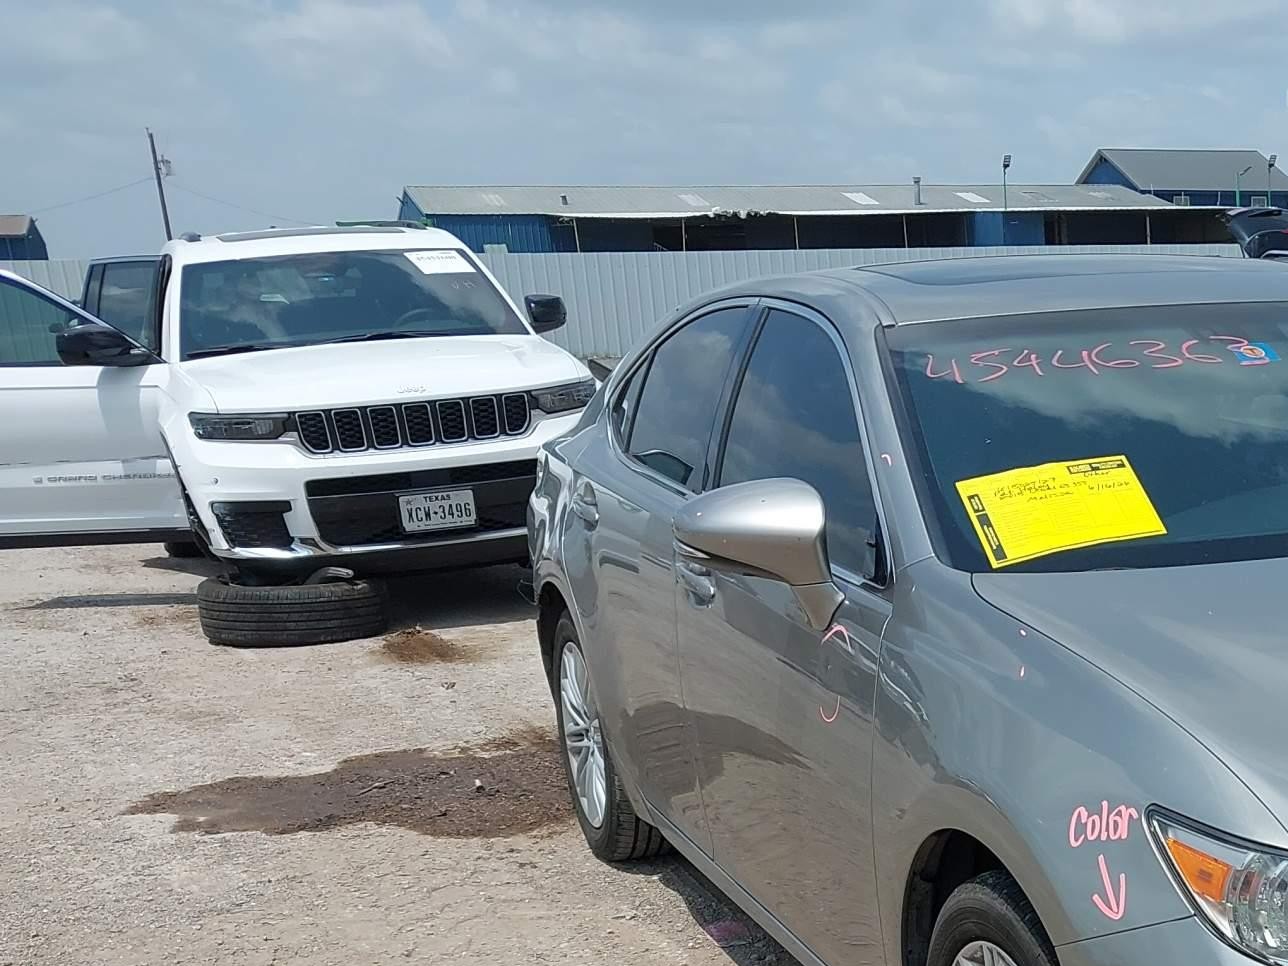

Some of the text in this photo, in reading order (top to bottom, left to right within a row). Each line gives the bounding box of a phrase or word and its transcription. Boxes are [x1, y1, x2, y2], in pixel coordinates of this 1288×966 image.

[925, 334, 1270, 384] 45446363
[423, 494, 451, 503] TEXAS
[1069, 800, 1139, 848] Color
